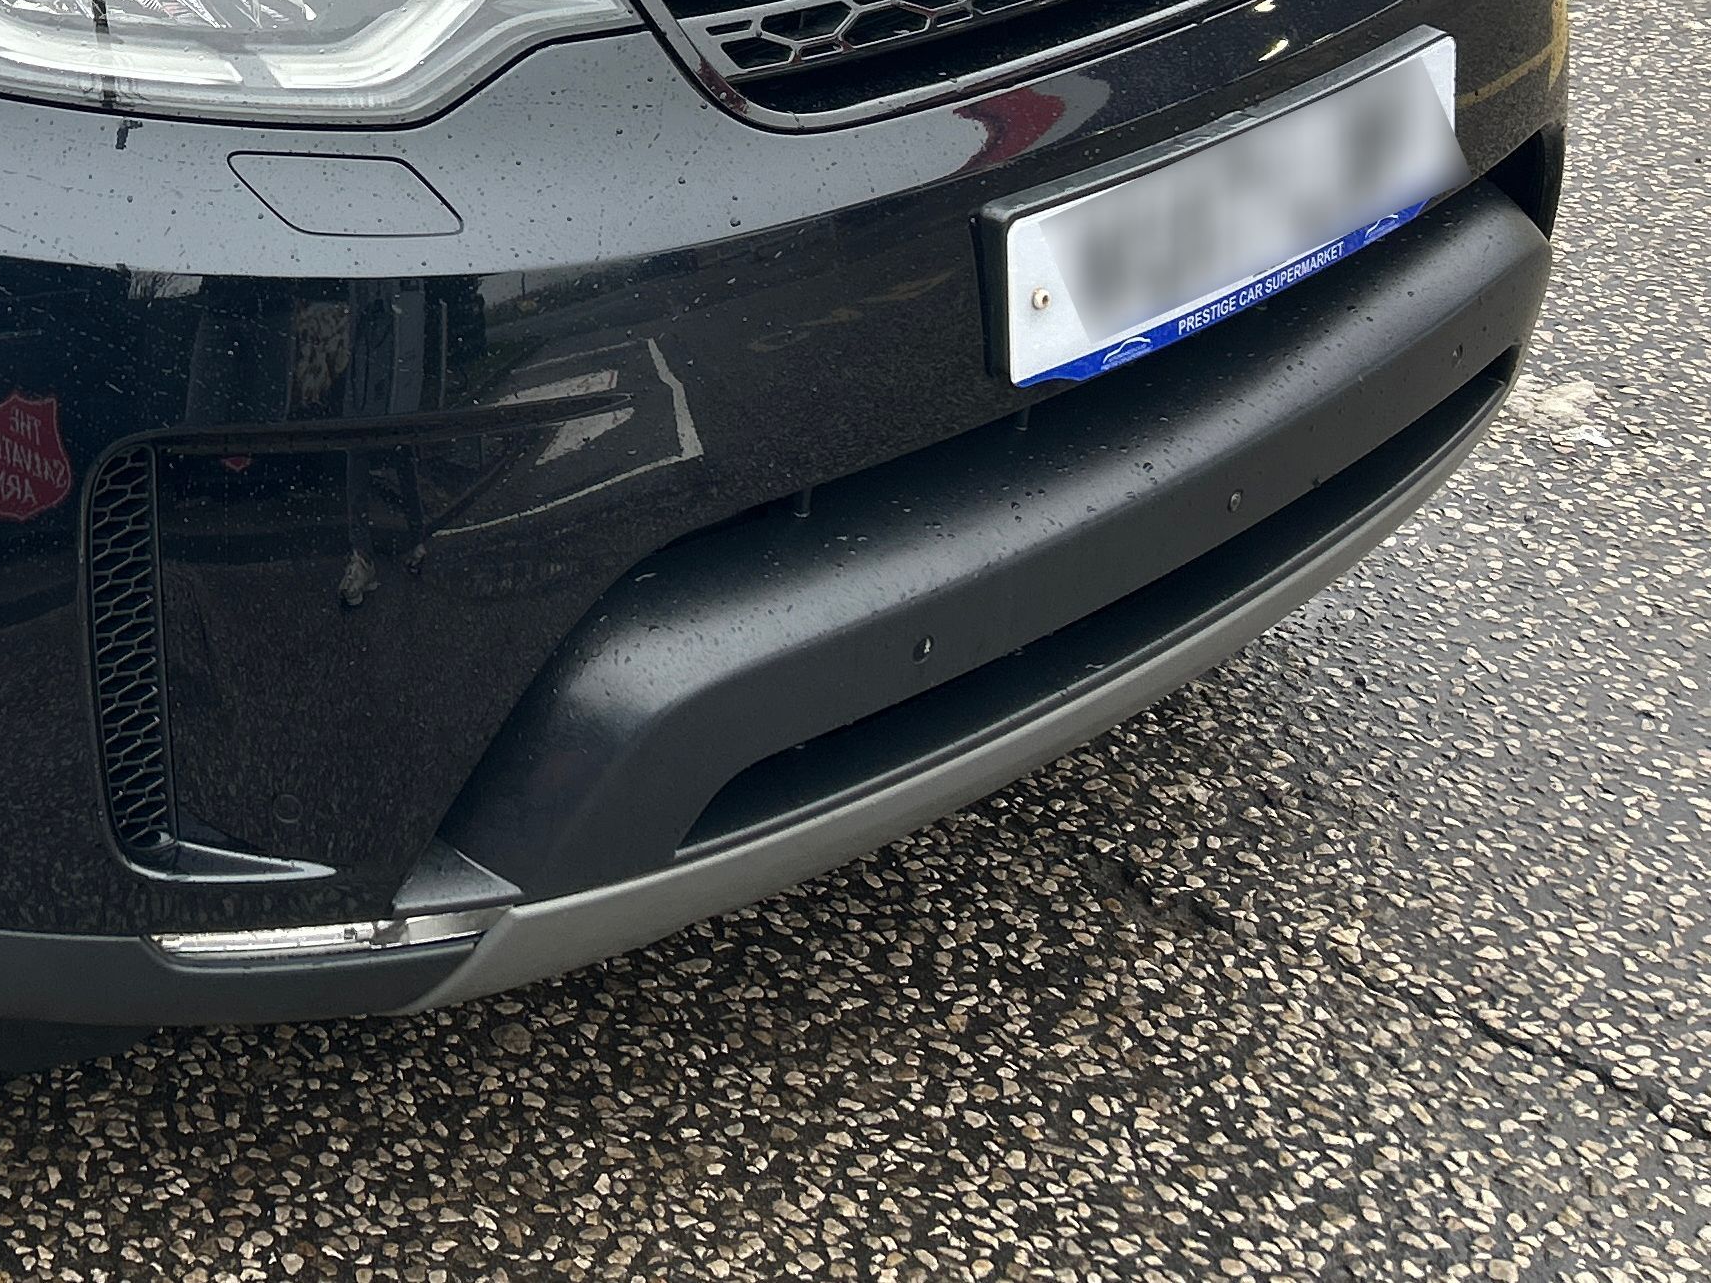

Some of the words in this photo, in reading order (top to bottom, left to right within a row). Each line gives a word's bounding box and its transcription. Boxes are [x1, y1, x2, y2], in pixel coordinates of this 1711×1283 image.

[1178, 296, 1236, 335] PRESTIGE
[1239, 283, 1263, 306] CAR
[1265, 241, 1345, 293] SUPERMARKET
